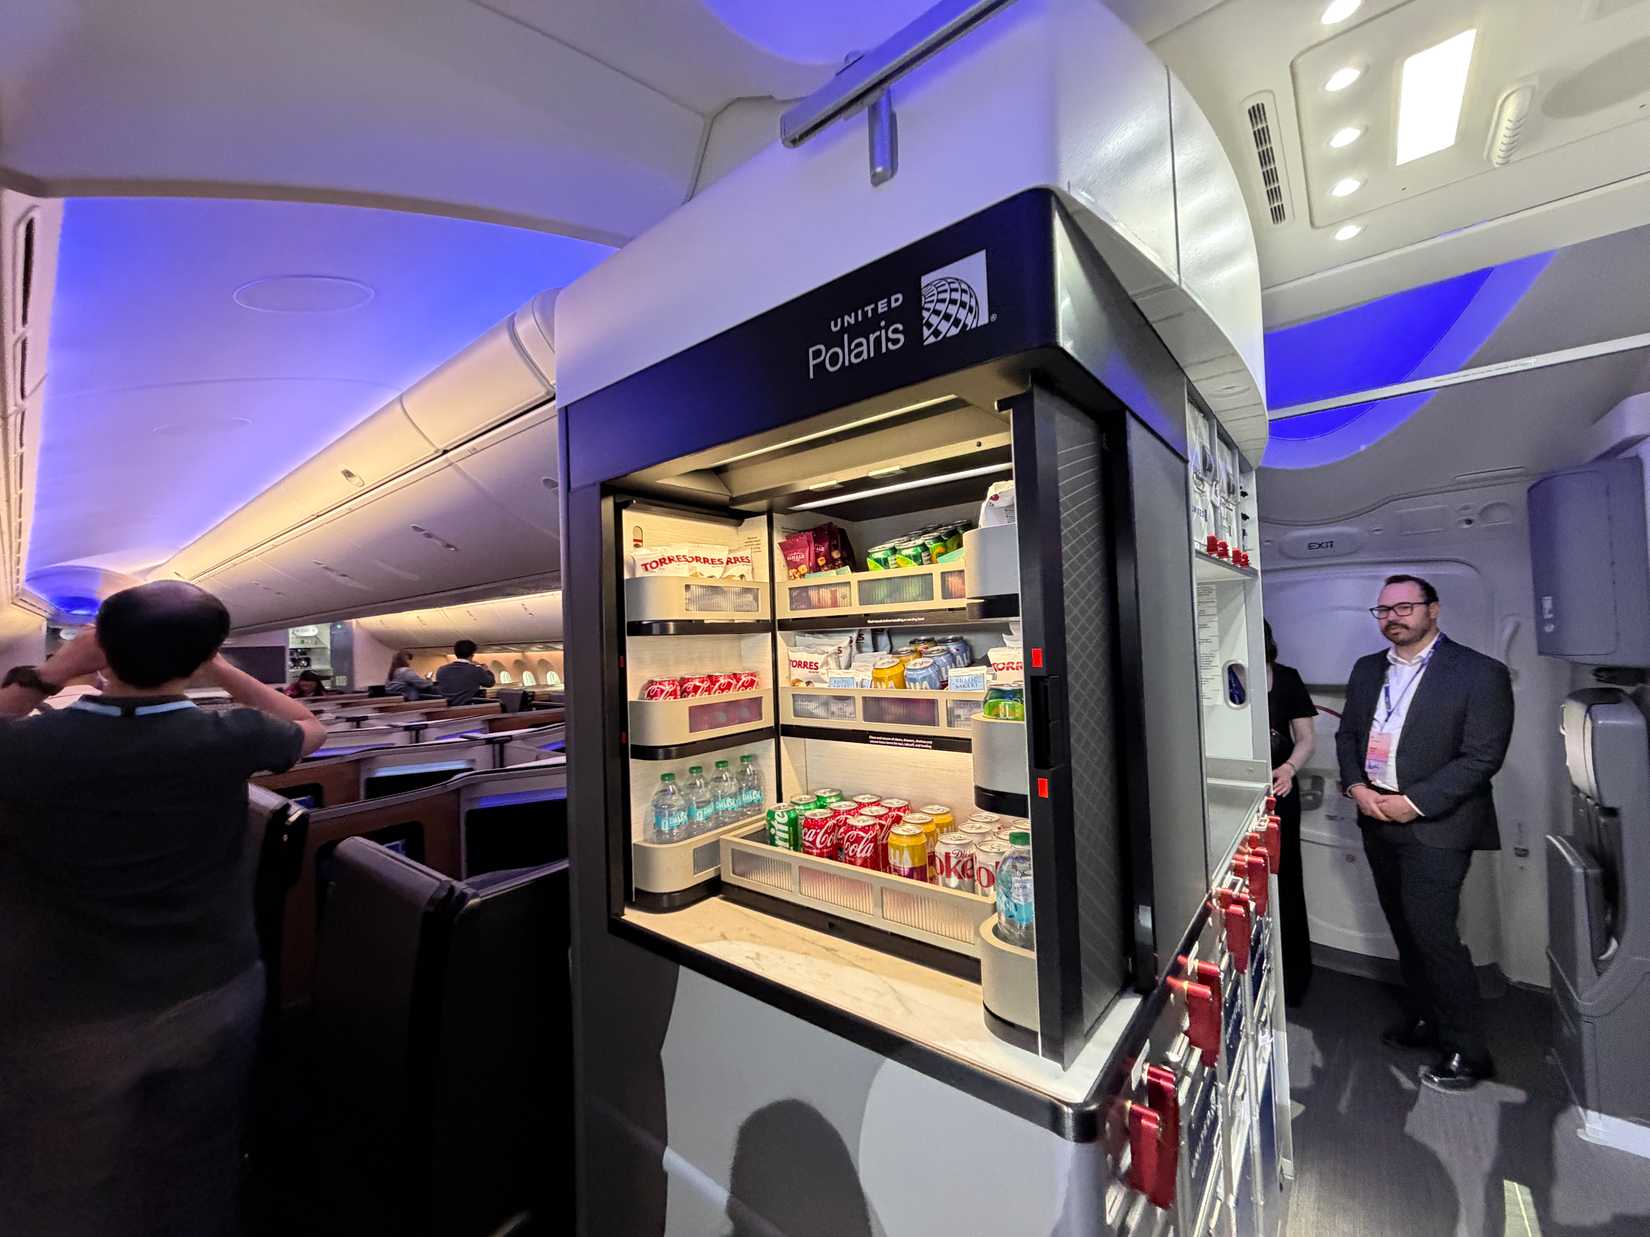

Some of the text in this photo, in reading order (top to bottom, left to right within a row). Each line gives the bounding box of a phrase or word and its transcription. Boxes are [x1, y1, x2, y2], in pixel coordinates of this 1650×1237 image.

[830, 293, 904, 332] UNITED
[808, 321, 905, 380] Polaris
[1307, 540, 1334, 551] EXIT
[790, 659, 819, 671] ORRES
[991, 661, 1024, 672] TORR
